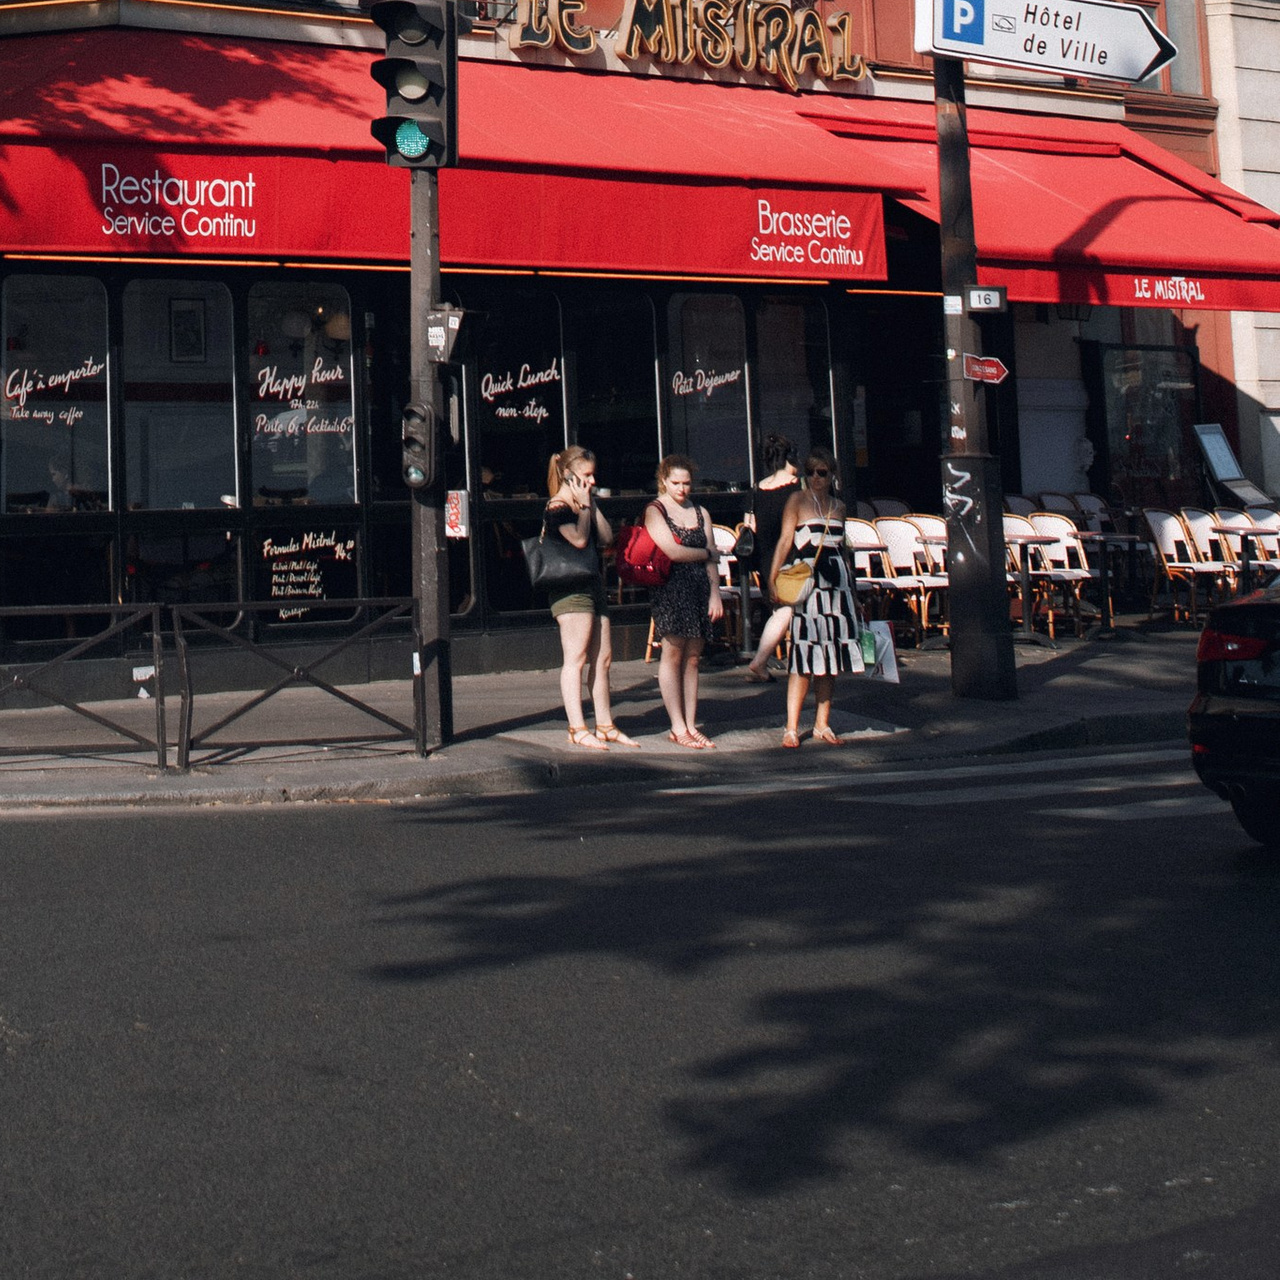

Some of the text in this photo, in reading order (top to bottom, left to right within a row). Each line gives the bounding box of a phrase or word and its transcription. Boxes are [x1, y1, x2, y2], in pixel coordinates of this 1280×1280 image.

[1023, 3, 1082, 32] Hôtel
[1023, 33, 1108, 65] de Ville
[101, 163, 256, 207] Restaurant
[101, 208, 256, 237] Service Continu
[758, 199, 851, 239] Brasserie
[750, 237, 863, 265] Service Continu
[977, 293, 992, 305] 16
[1134, 276, 1205, 304] LE MISTRAL
[6, 368, 38, 406] Café
[49, 356, 105, 393] emporter
[258, 357, 344, 399] Happy hour
[481, 357, 560, 401] Quick Lunch
[672, 371, 694, 395] Petit
[10, 405, 84, 425] Take away coffee
[495, 398, 549, 424] non-stop
[263, 530, 336, 558] Formules Mistral
